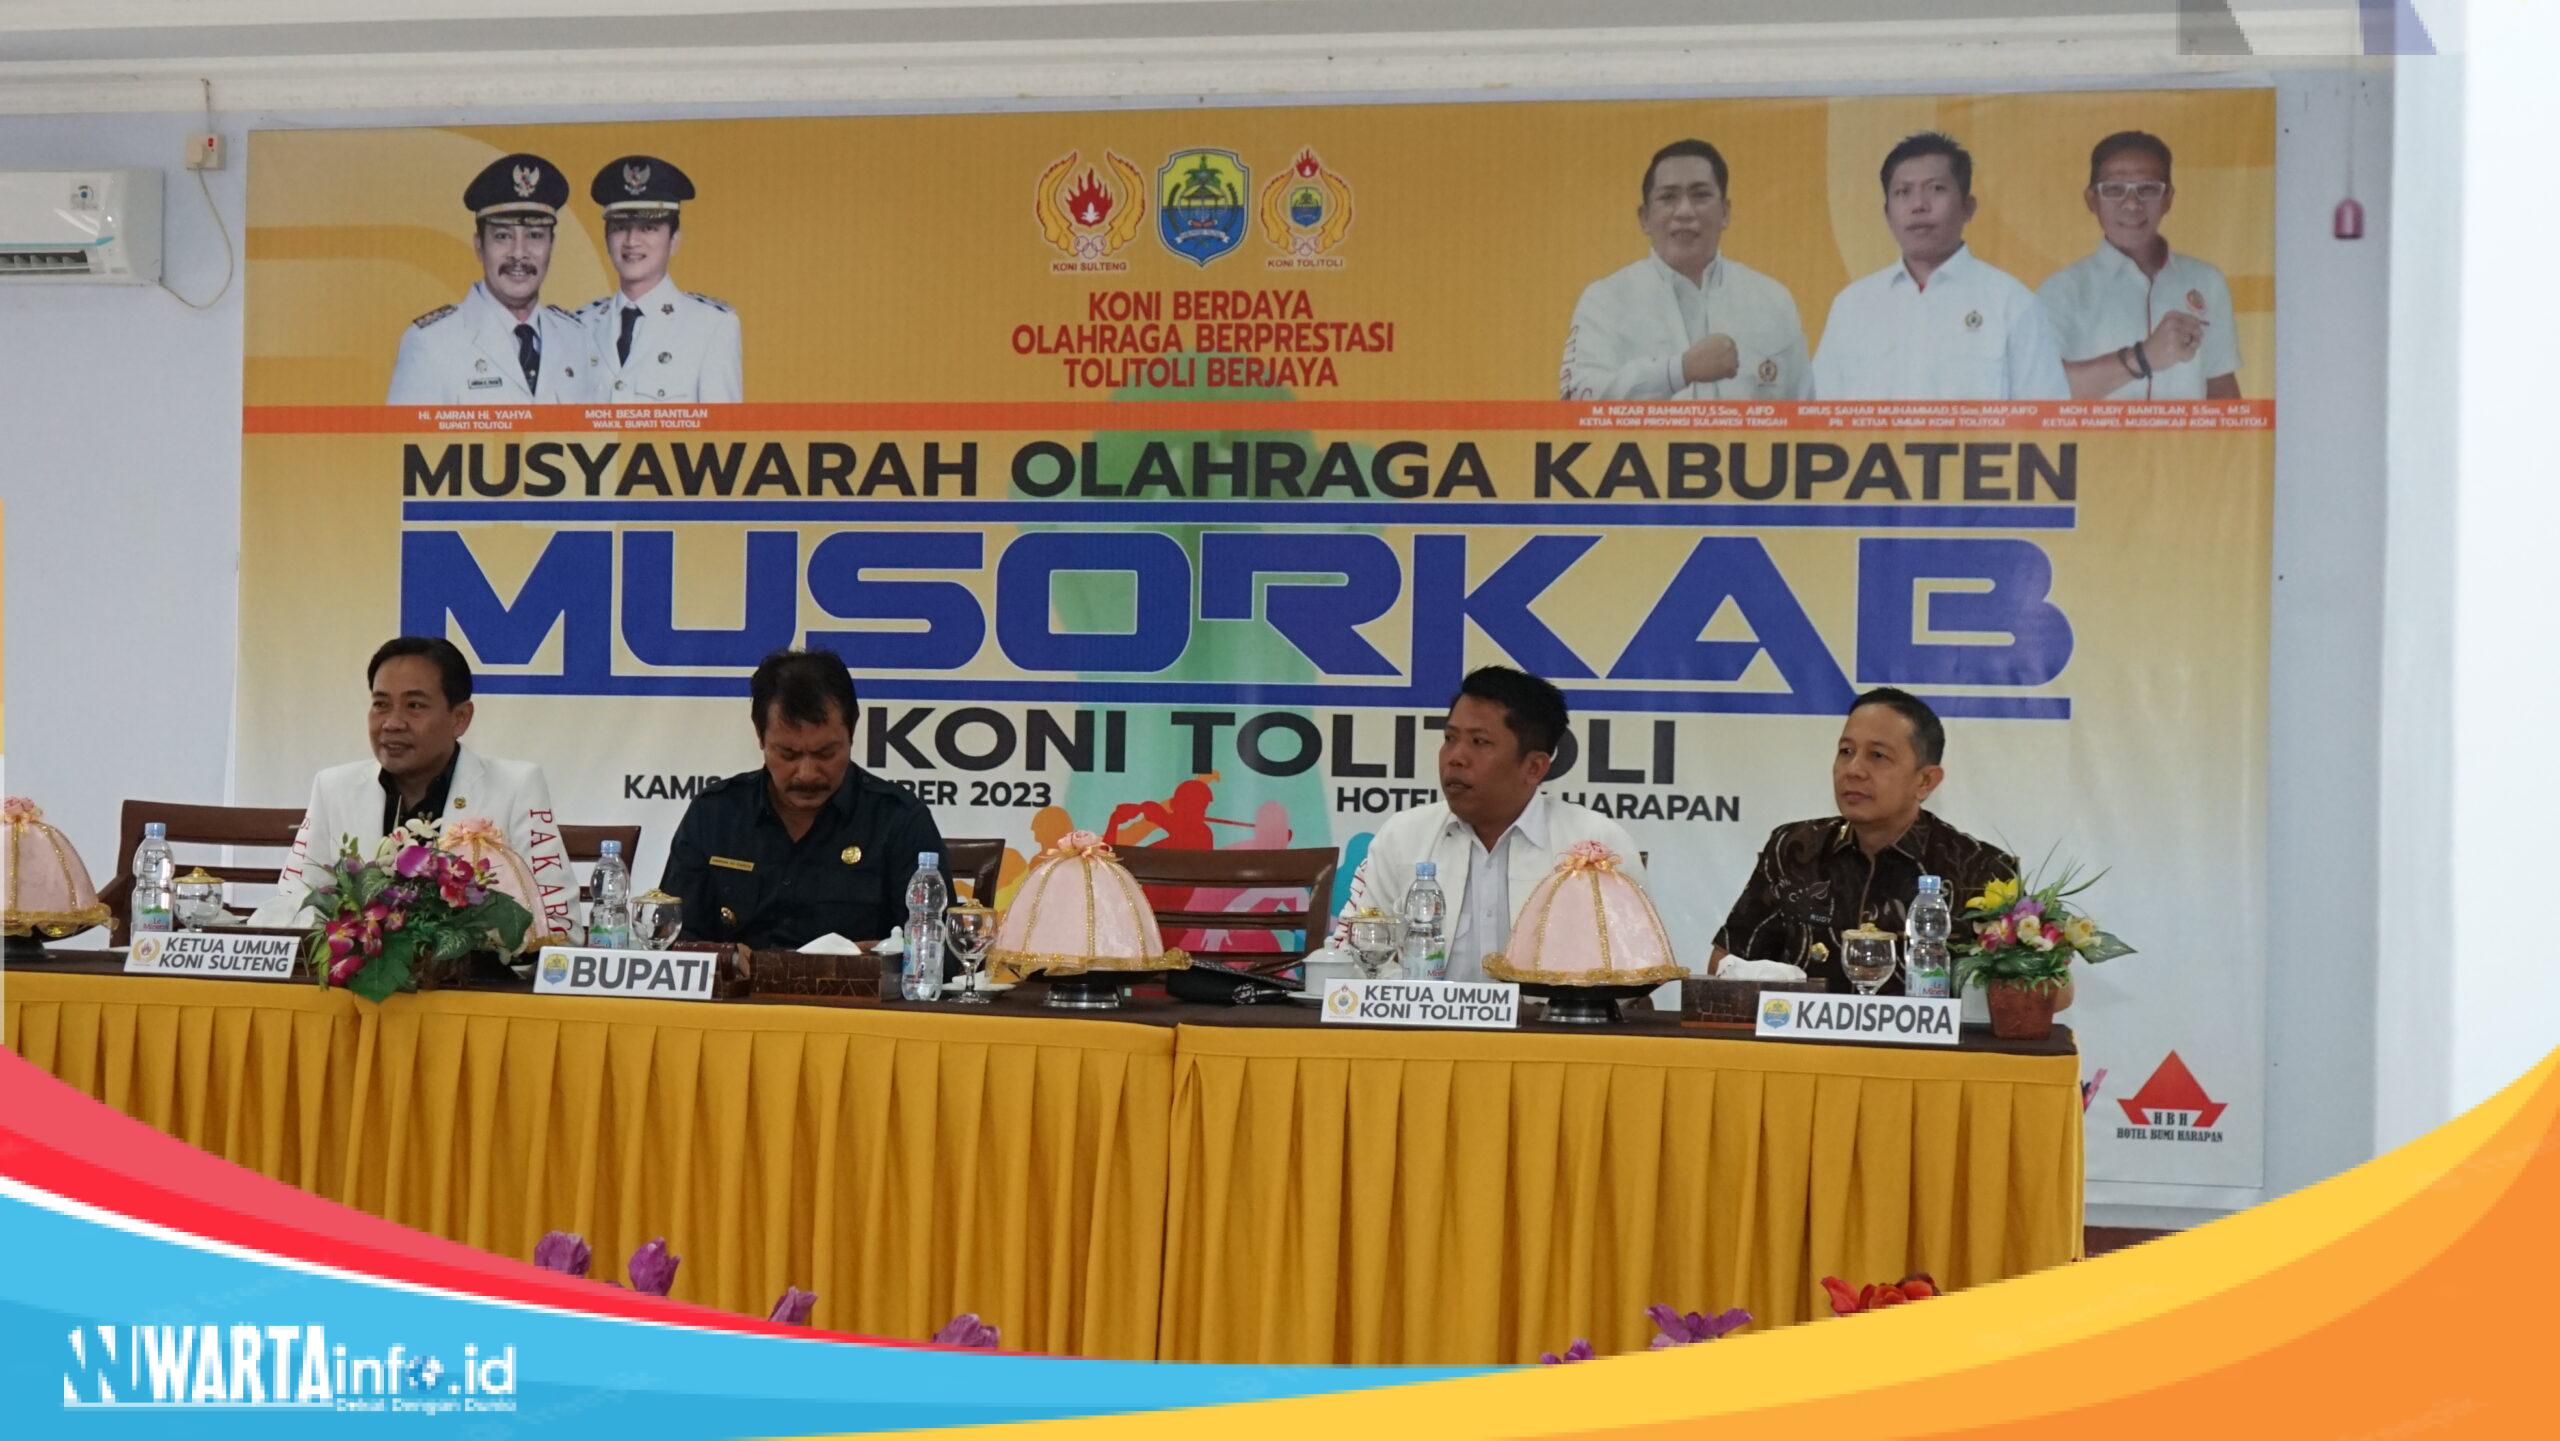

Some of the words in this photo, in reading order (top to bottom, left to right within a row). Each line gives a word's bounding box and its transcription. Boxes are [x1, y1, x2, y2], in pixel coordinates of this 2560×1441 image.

[1053, 262, 1077, 272] KONI
[1080, 262, 1127, 271] SULTENG
[1267, 259, 1294, 268] KONI
[1297, 259, 1343, 267] TOLITOLI
[1089, 292, 1161, 321] KONI
[1173, 290, 1313, 320] BERDAYA
[1012, 324, 1182, 355] OLAHRAGA
[1196, 322, 1393, 352] BERPRESTASI
[1063, 358, 1195, 388] TOLITOLI
[1207, 358, 1338, 387] BERJAYA
[435, 410, 475, 420] AMRAN
[494, 410, 532, 419] YAHYA
[615, 409, 651, 418] BESAR
[654, 409, 707, 418] BANTILAN
[1609, 406, 1644, 416] NIZAR
[438, 421, 470, 430] BUPATI
[473, 421, 512, 429] TOLITOLI
[625, 420, 656, 428] BUPATI
[660, 420, 700, 428] TOLITOLI
[1579, 418, 1612, 427] KETUA
[1616, 418, 1640, 427] KONI
[1643, 418, 1690, 427] PROVINSI
[1694, 418, 1742, 427] SULAWESI
[1747, 418, 1788, 427] TENGAH
[1852, 418, 1888, 427] KETUA
[1960, 418, 2006, 427] TOLITOLI
[2041, 418, 2078, 427] KETUA
[2220, 418, 2267, 427] TOLITOLI
[403, 442, 977, 497] MUSYAWARAH
[1011, 441, 1497, 498] OLAHRAGA
[1534, 442, 2077, 501] KABUPATEN
[401, 529, 2074, 690] MUSORKAB
[867, 706, 1127, 773] KONI
[1170, 710, 1676, 785] TOLILI
[971, 782, 1052, 807] 2023
[166, 937, 225, 954] KETUA
[233, 940, 290, 956] UMUM
[159, 954, 203, 968] KONI
[208, 955, 289, 972] SULTENG
[570, 956, 709, 992] BUPATI
[1365, 985, 1434, 1002] KETUA
[1443, 988, 1510, 1005] UMUM
[1360, 1002, 1410, 1019] KONI
[1419, 1004, 1511, 1021] TOLITOLI
[1796, 1001, 1953, 1035] KADISPORA
[2117, 1128, 2148, 1139] HOTEL
[2150, 1129, 2175, 1140] BUMI
[2177, 1130, 2223, 1142] HARAPAN
